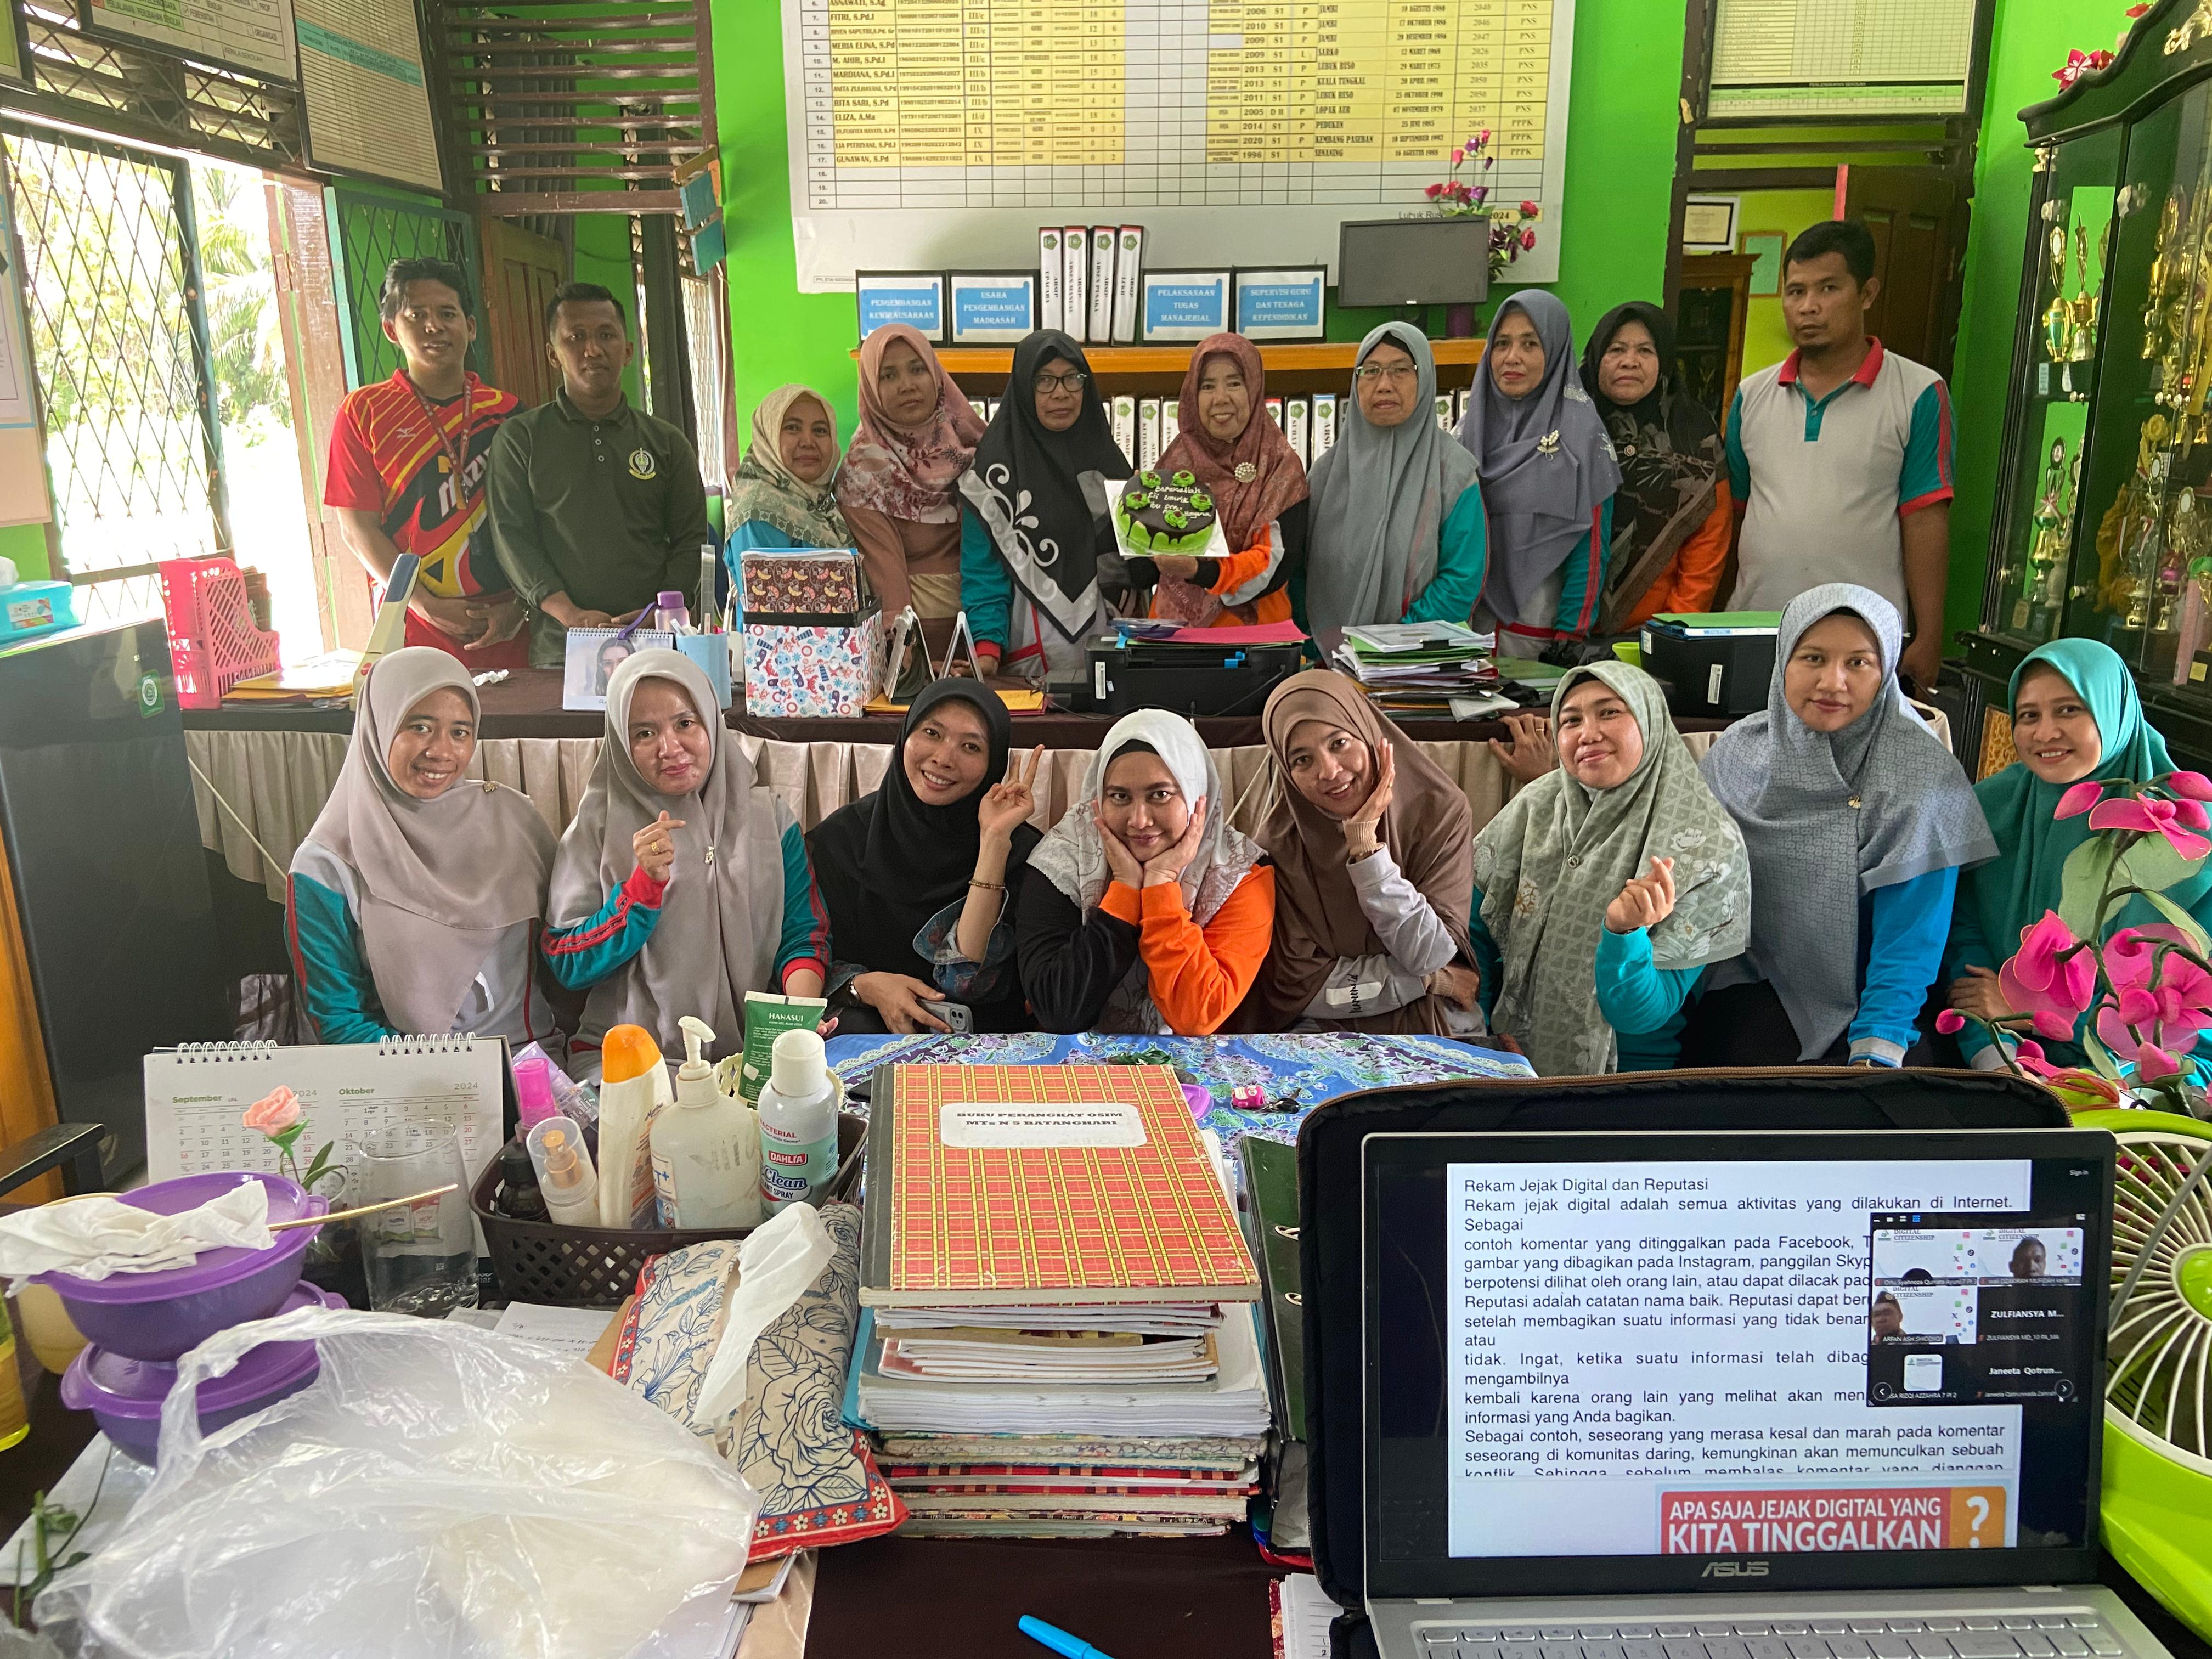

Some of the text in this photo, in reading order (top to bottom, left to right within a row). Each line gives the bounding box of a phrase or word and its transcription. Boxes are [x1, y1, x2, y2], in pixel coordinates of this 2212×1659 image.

[1158, 289, 1215, 297] PELAKSANAAN
[871, 298, 932, 307] PENGEMBANGAN
[869, 311, 934, 319] KEWIRAUSAHAAN
[973, 316, 1016, 324] MADRASAH
[1252, 313, 1308, 322] KEPENDIDIKAN
[769, 1013, 803, 1022] HANASUI
[172, 1095, 222, 1104] September
[770, 1152, 803, 1164] DAHLIA
[774, 1188, 794, 1199] SPRAY
[1465, 1177, 1708, 1195] Rekam Jejak Digital dan Reputasi
[1465, 1195, 2012, 1215] Rekam jejak digital adalah semua aktivitas yang dilakukan di Internet.
[1464, 1218, 1523, 1234] Sebagai
[1464, 1235, 1854, 1253] contoh komentar yang ditinggalkan pada Facebook,
[1464, 1254, 1831, 1273] gambar yang dibagikan pada Instagram, panggilan
[1464, 1273, 1839, 1292] berpotensi dilihat oleh orang lain, atau dapat dilacak
[1465, 1293, 1839, 1311] Reputasi adalah catatan nama baik. Reputasi dapat
[1464, 1312, 1820, 1330] setelah membagikan suatu informasi yang tidak
[1465, 1409, 1675, 1426] informasi yang Anda bagikan.
[1669, 1497, 1941, 1520] APA SAJA JEJAK DIGITAL YANG
[1669, 1496, 1989, 1554] KITA TINGGALKAN ?
[1701, 1561, 1769, 1577] ASUS
